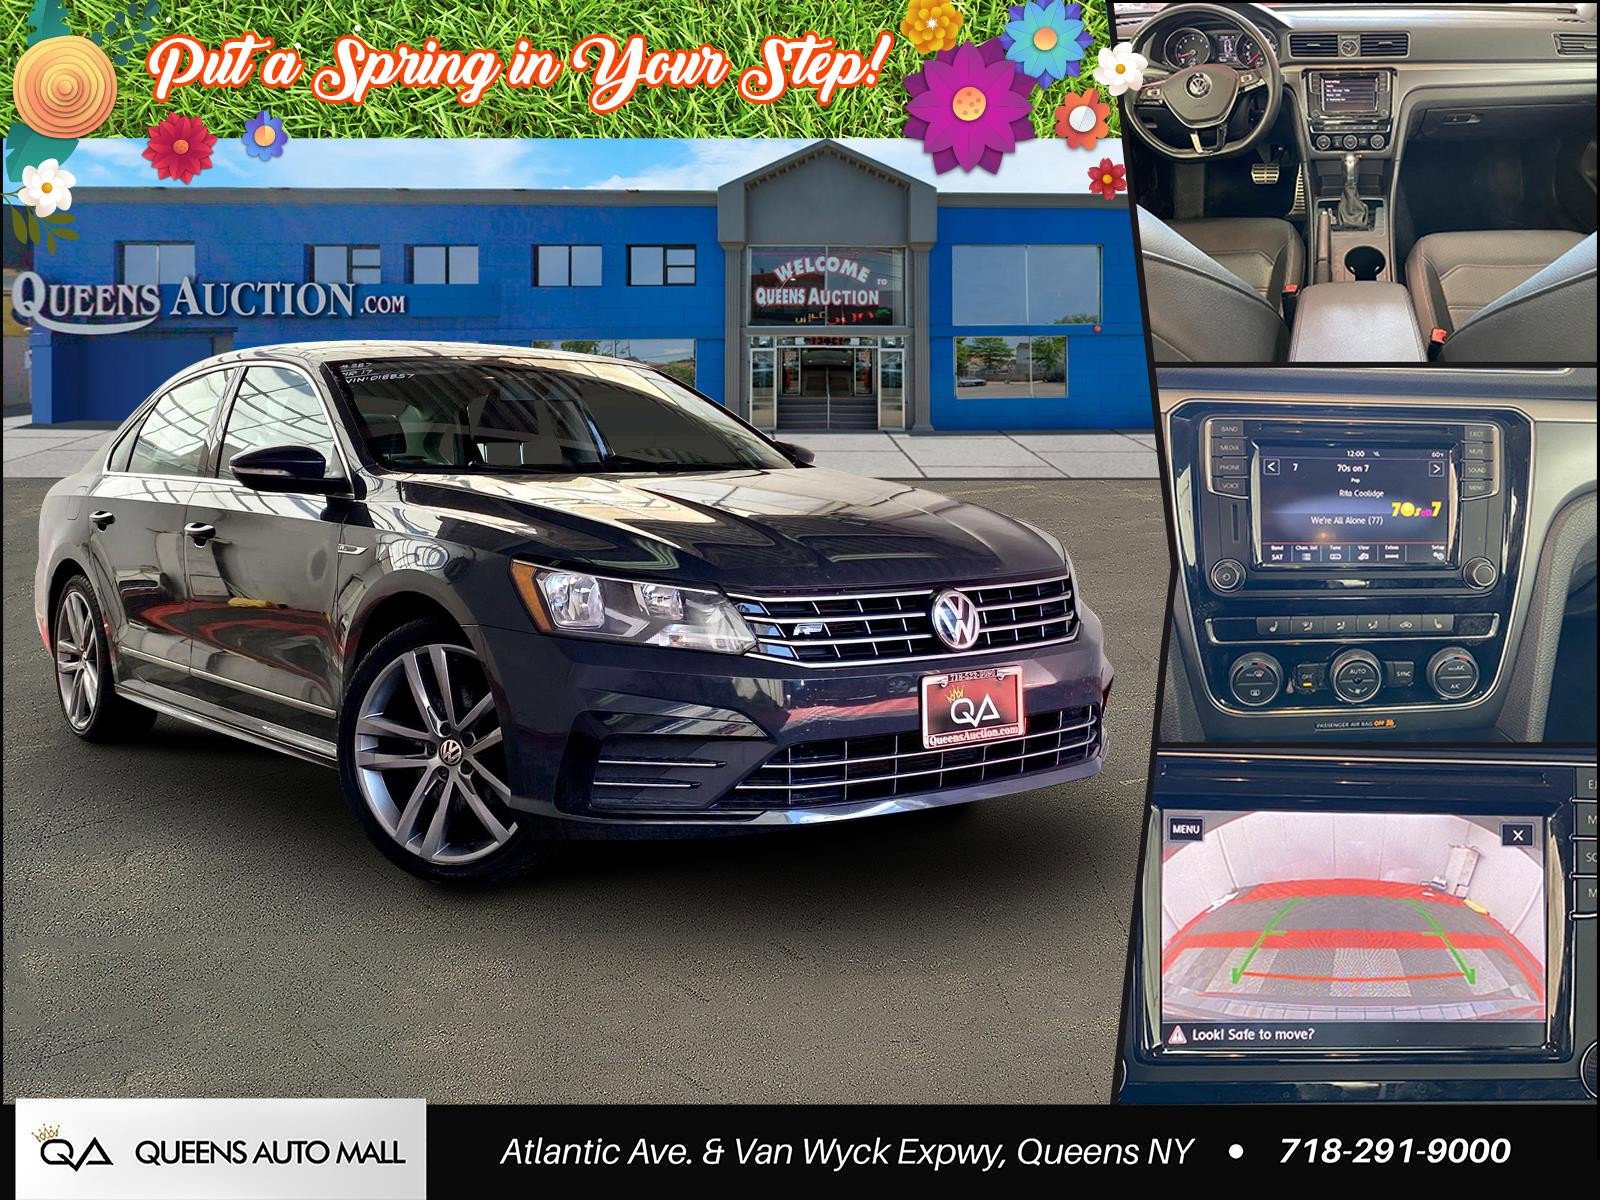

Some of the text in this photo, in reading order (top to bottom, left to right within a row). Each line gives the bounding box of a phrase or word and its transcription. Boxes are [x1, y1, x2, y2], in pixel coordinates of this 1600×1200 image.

[774, 256, 871, 283] WELCOME
[755, 287, 880, 306] QUEENS AUCTION
[12, 271, 405, 334] QUEENS AUCTION .COM
[1347, 450, 1365, 458] 12:00
[1292, 463, 1299, 472] 7
[1337, 464, 1351, 473] 70s
[1364, 464, 1370, 473] 7
[1339, 489, 1385, 499] Rita Coolidge
[1311, 516, 1384, 526] We're All Alone (77)
[1272, 553, 1284, 561] SAT
[929, 725, 1019, 746] QueensAuction.com
[1172, 824, 1200, 834] MENU
[1228, 1028, 1255, 1041] Safe
[1258, 1029, 1272, 1041] to
[1275, 1028, 1316, 1041] move?
